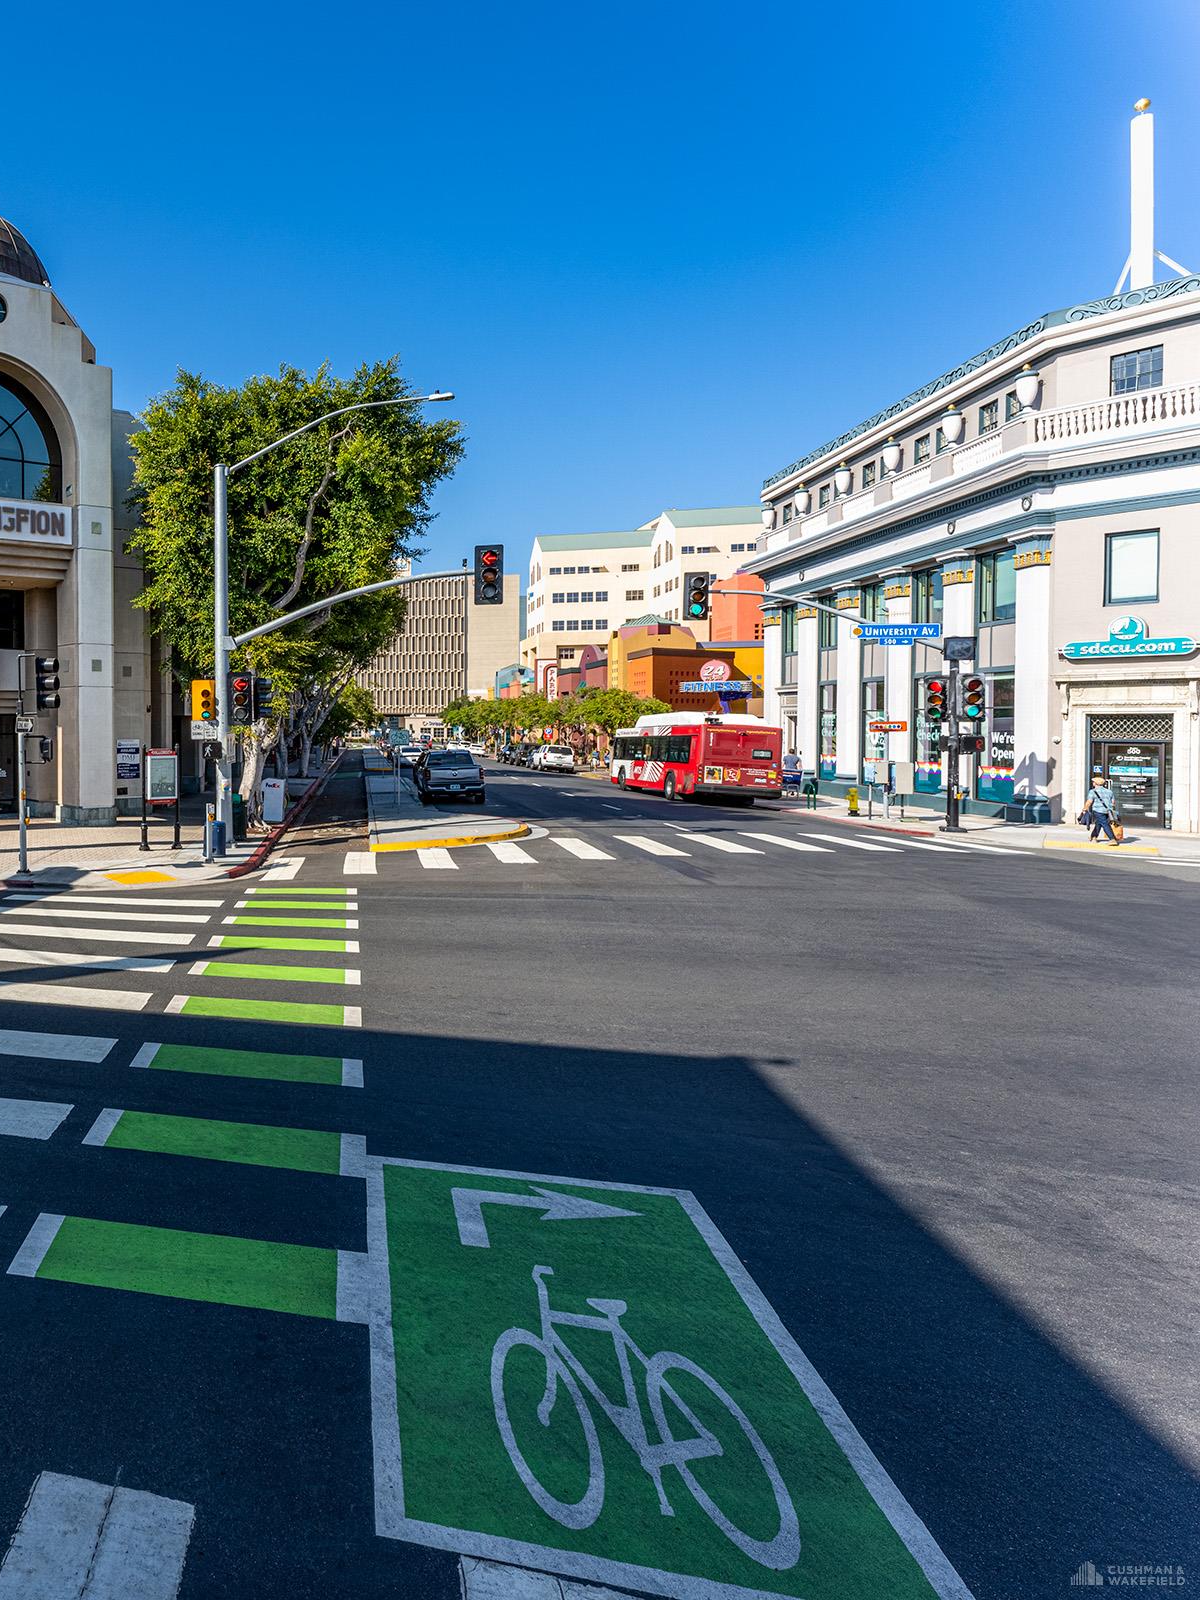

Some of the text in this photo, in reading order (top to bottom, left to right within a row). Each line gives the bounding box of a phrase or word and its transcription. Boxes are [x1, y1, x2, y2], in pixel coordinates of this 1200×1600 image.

[865, 627, 919, 636] UNIVERSITY
[1080, 642, 1176, 655] sdccu.com
[703, 665, 725, 677] 24
[684, 682, 742, 692] FITNESS
[991, 731, 1015, 744] We're
[991, 746, 1014, 761] Open
